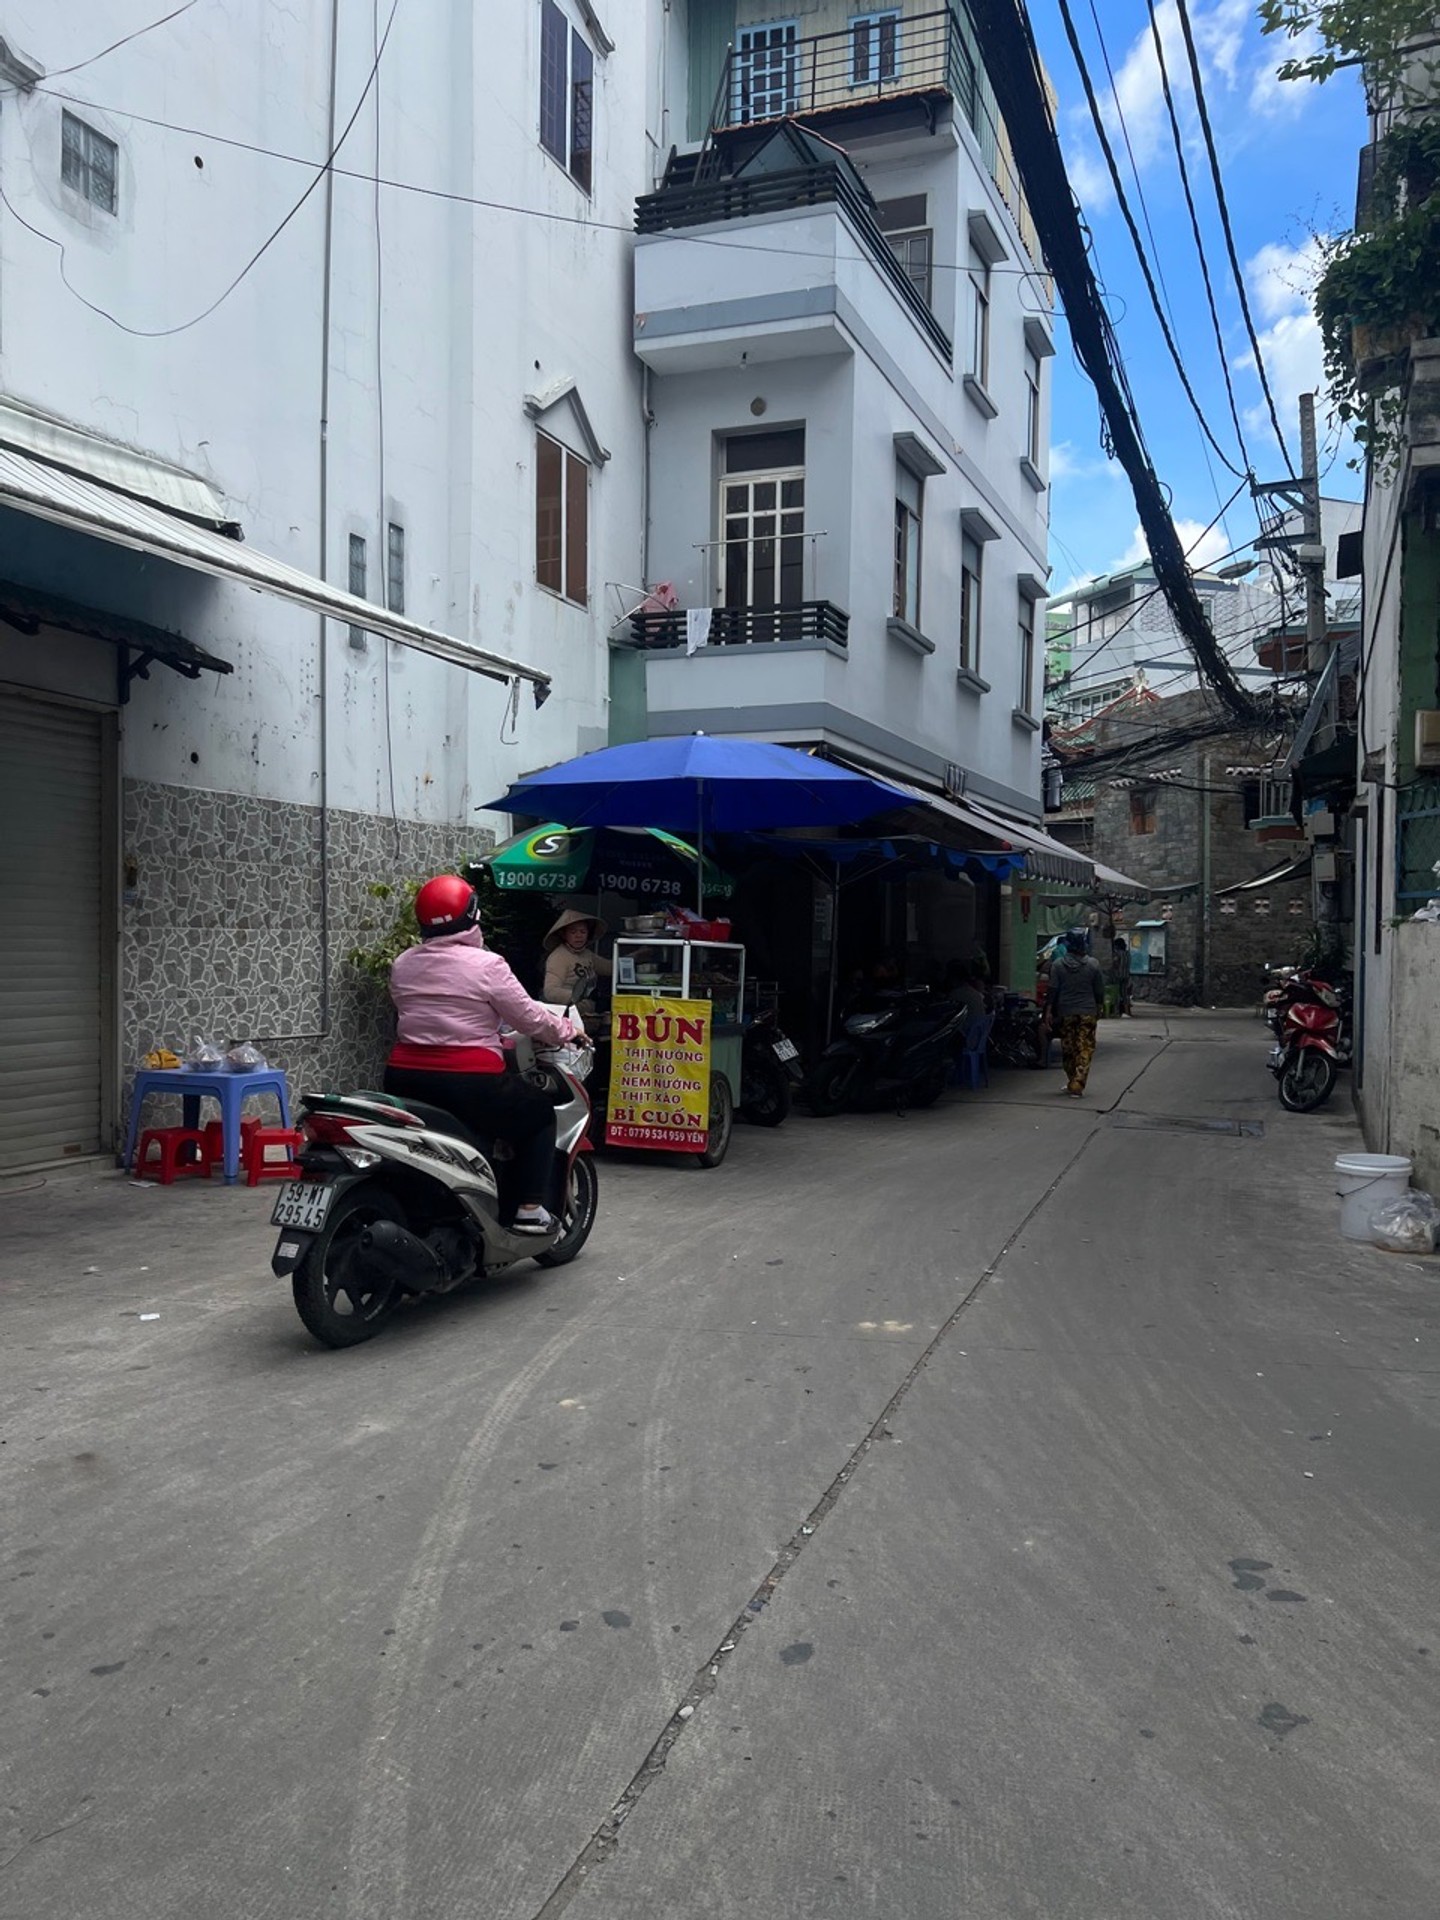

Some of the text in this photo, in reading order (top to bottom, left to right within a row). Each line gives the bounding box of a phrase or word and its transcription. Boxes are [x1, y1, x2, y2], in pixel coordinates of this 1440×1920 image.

[498, 871, 577, 889] 1900 6738
[597, 873, 638, 891] 1900
[641, 878, 682, 895] 6738
[616, 1008, 705, 1046] BÚN
[625, 1048, 653, 1060] THỊT
[621, 1077, 651, 1088] NEM
[621, 1091, 652, 1103] THỊT
[641, 1107, 703, 1127] CUỐN
[629, 1127, 651, 1139] 0779
[651, 1128, 668, 1141] 534
[669, 1130, 685, 1142] 959
[275, 1203, 325, 1228] 295.45
